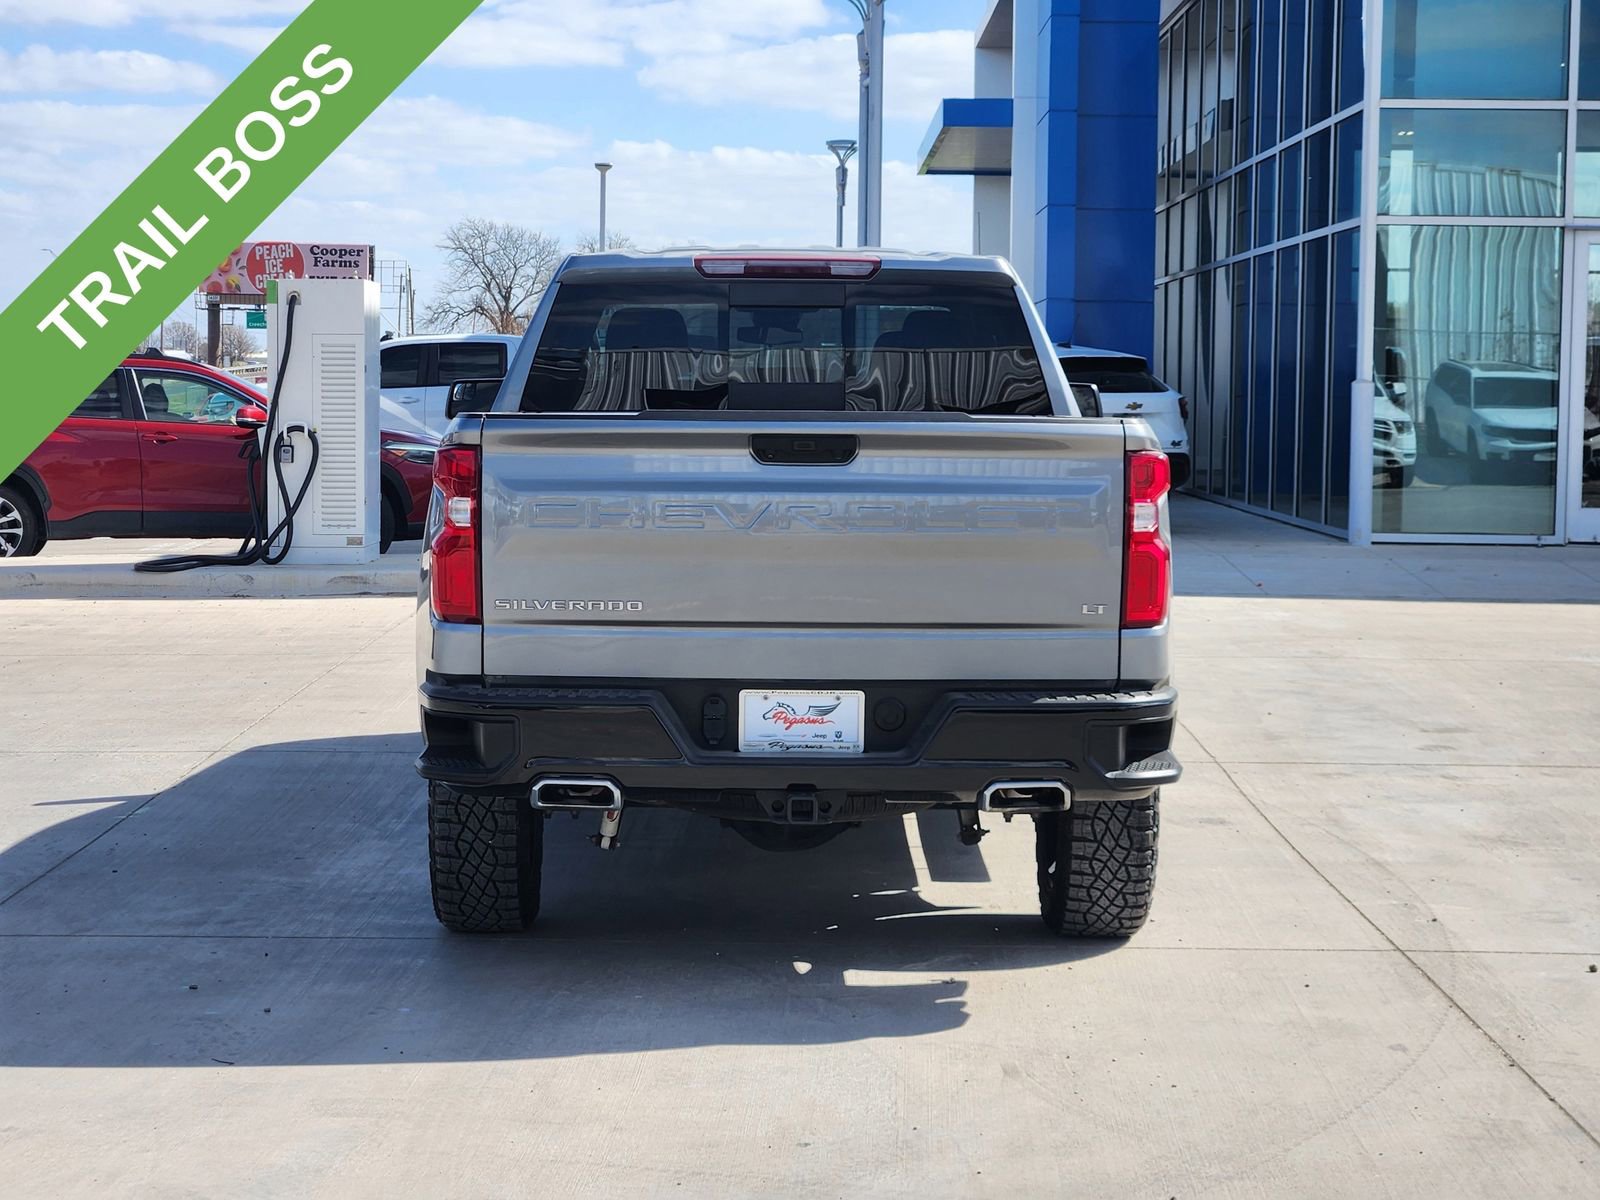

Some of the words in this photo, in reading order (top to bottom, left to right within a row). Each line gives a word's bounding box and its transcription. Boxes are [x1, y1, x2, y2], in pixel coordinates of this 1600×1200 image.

[255, 244, 294, 260] PEACH
[309, 245, 364, 257] Cooper
[265, 259, 284, 273] ICE
[313, 257, 360, 268] Farms
[528, 499, 1083, 533] CHEVROLET
[495, 600, 643, 611] SILVERADO
[1082, 604, 1108, 615] LT
[772, 711, 835, 730] Pegasus
